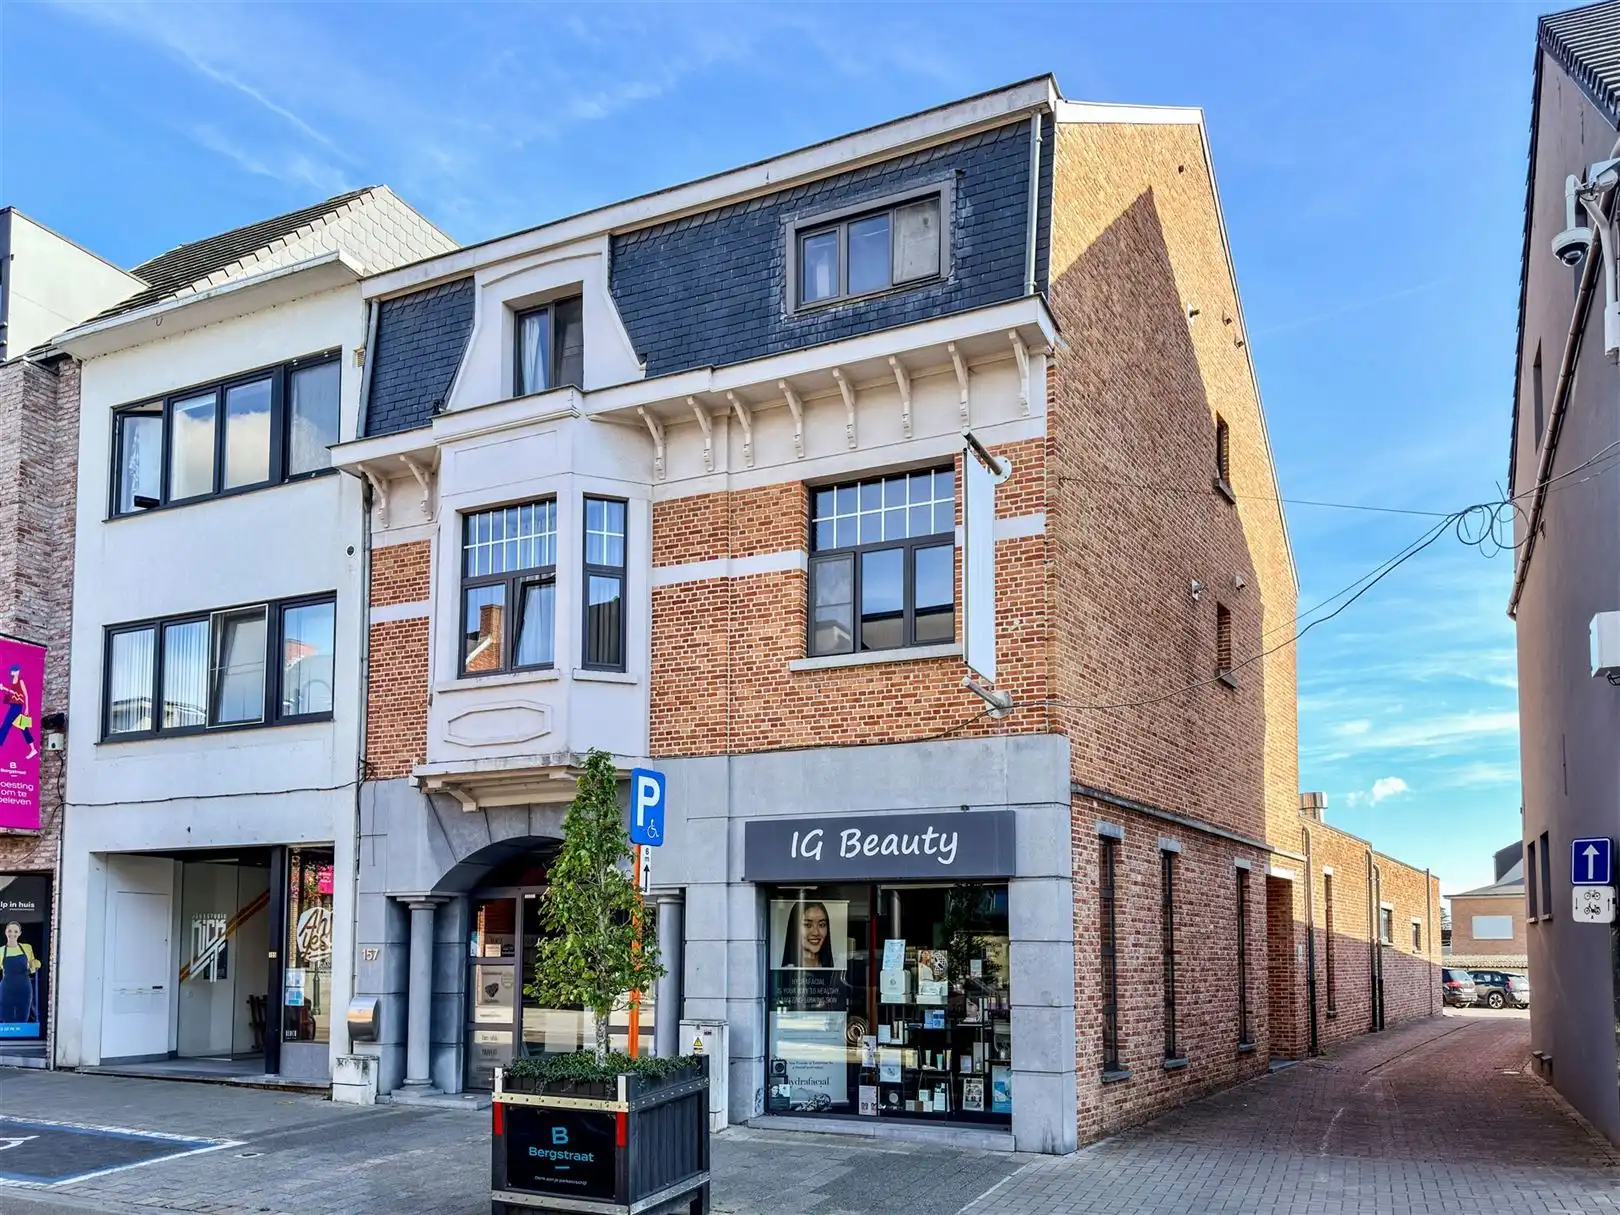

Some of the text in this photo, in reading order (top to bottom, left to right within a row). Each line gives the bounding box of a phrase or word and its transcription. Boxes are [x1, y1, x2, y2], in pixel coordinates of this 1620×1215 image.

[0, 781, 34, 792] oesting
[1, 789, 27, 798] om te
[637, 775, 660, 826] P
[645, 847, 650, 855] 6
[791, 826, 958, 865] IG Beauty
[18, 900, 35, 908] huis
[361, 948, 379, 960] 157
[789, 1076, 830, 1088] ydrafacial
[552, 1127, 569, 1144] B
[529, 1146, 595, 1162] Bergstraat
